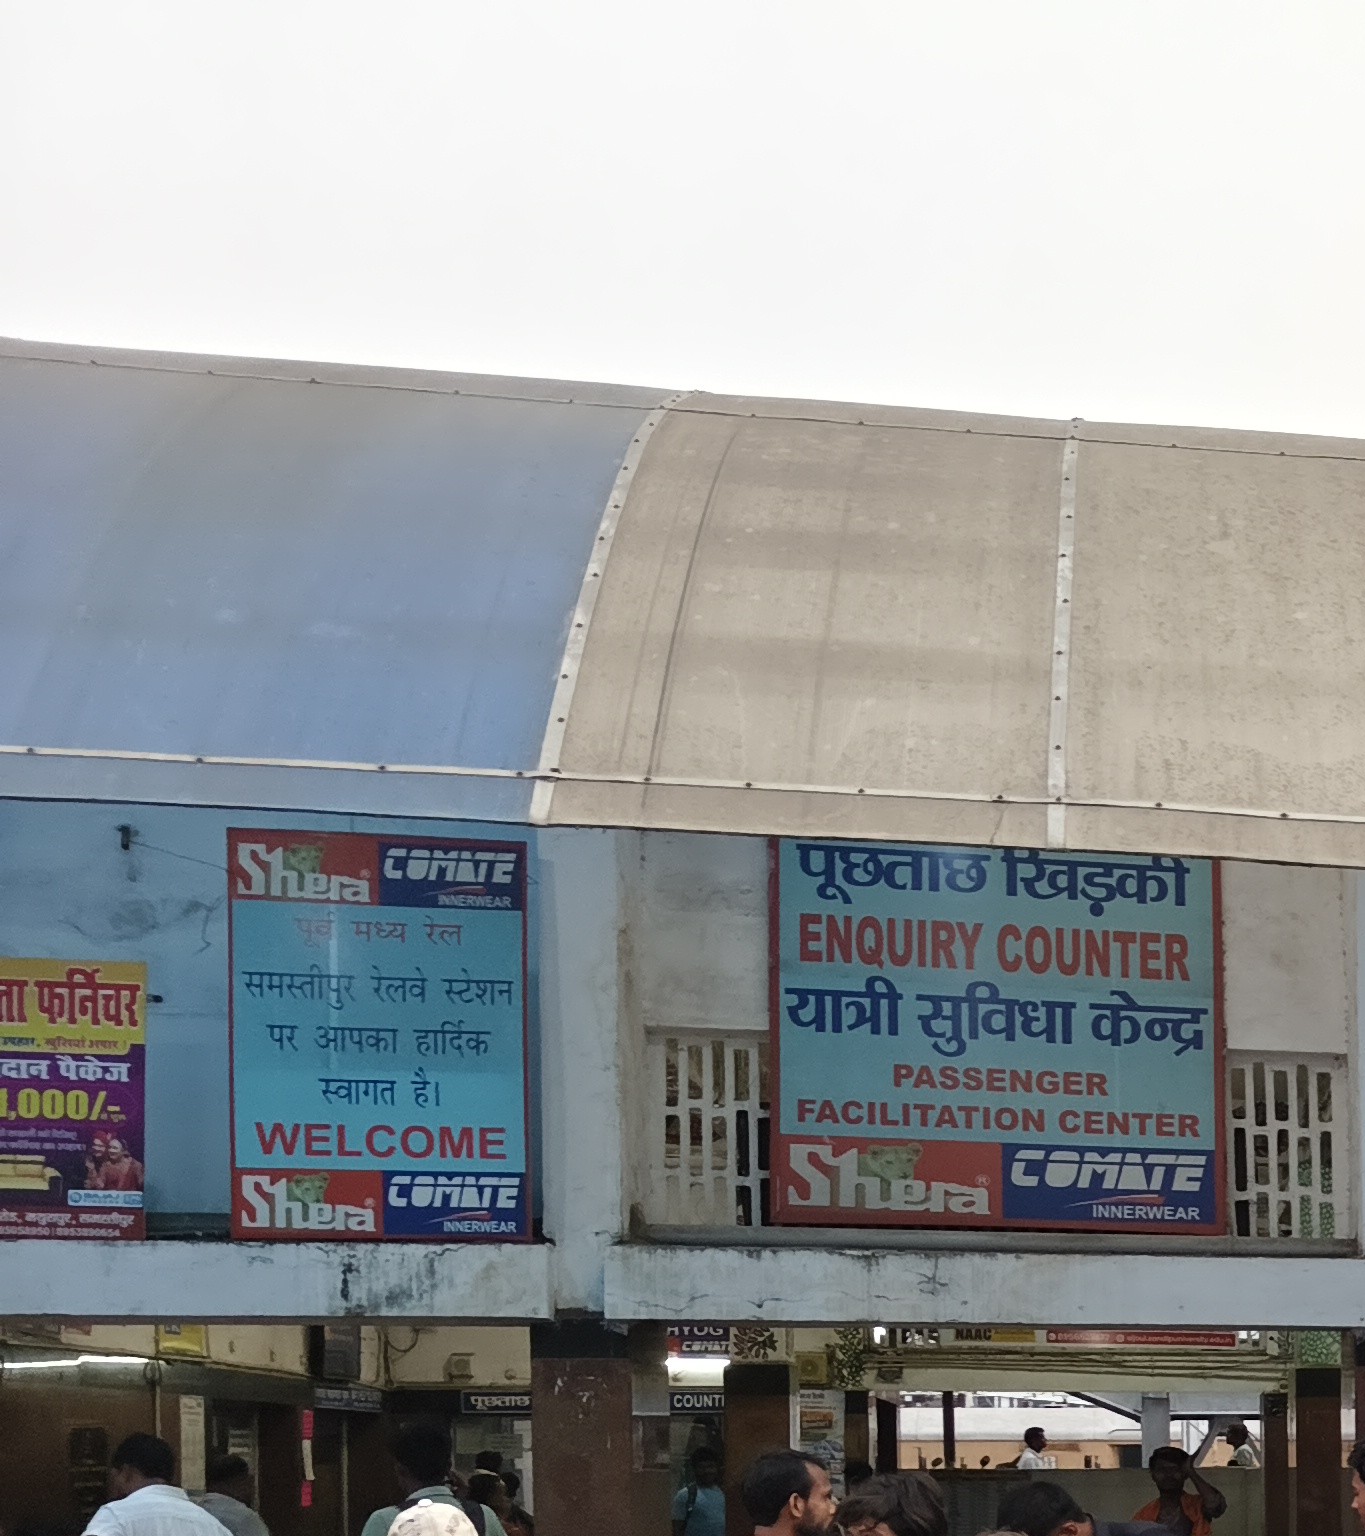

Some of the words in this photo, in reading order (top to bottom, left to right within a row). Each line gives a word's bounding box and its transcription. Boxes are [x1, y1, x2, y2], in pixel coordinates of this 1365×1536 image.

[237, 843, 371, 902] Shera
[796, 843, 990, 904] पूछताछ
[437, 895, 512, 908] INNERWEAR
[294, 911, 335, 946] पूर्व
[351, 919, 408, 943] मध्य
[423, 915, 463, 945] रेल
[799, 912, 983, 971] ENQUIRY
[997, 923, 1190, 982] COUNTER
[33, 967, 141, 1027] फर्निचर
[241, 963, 356, 1010] समस्तीपुर
[370, 965, 428, 1003] रेलवे
[441, 968, 514, 1006] स्टेशन
[784, 975, 903, 1036] यात्री
[916, 981, 1077, 1057] सुविधा
[1089, 990, 1209, 1056] केन्द्र
[266, 1024, 298, 1051] पर
[314, 1025, 399, 1054] आपका
[413, 1019, 492, 1058] हार्दिक
[0, 1058, 51, 1080] दान
[55, 1055, 131, 1082] पैकेज
[893, 1063, 1108, 1097] PASSENGER
[318, 1078, 397, 1106] स्वागत
[797, 1098, 1046, 1133] FACILITATION
[1058, 1109, 1200, 1138] CENTER
[254, 1122, 507, 1160] WELCOME
[787, 1143, 991, 1215] Shera
[241, 1175, 376, 1232] Shera
[1091, 1203, 1200, 1220] INNERWEAR
[443, 1221, 517, 1233] INNERWEAR
[667, 1327, 724, 1336] HYOG
[682, 1341, 730, 1351] COMAT
[955, 1328, 992, 1341] NAAC
